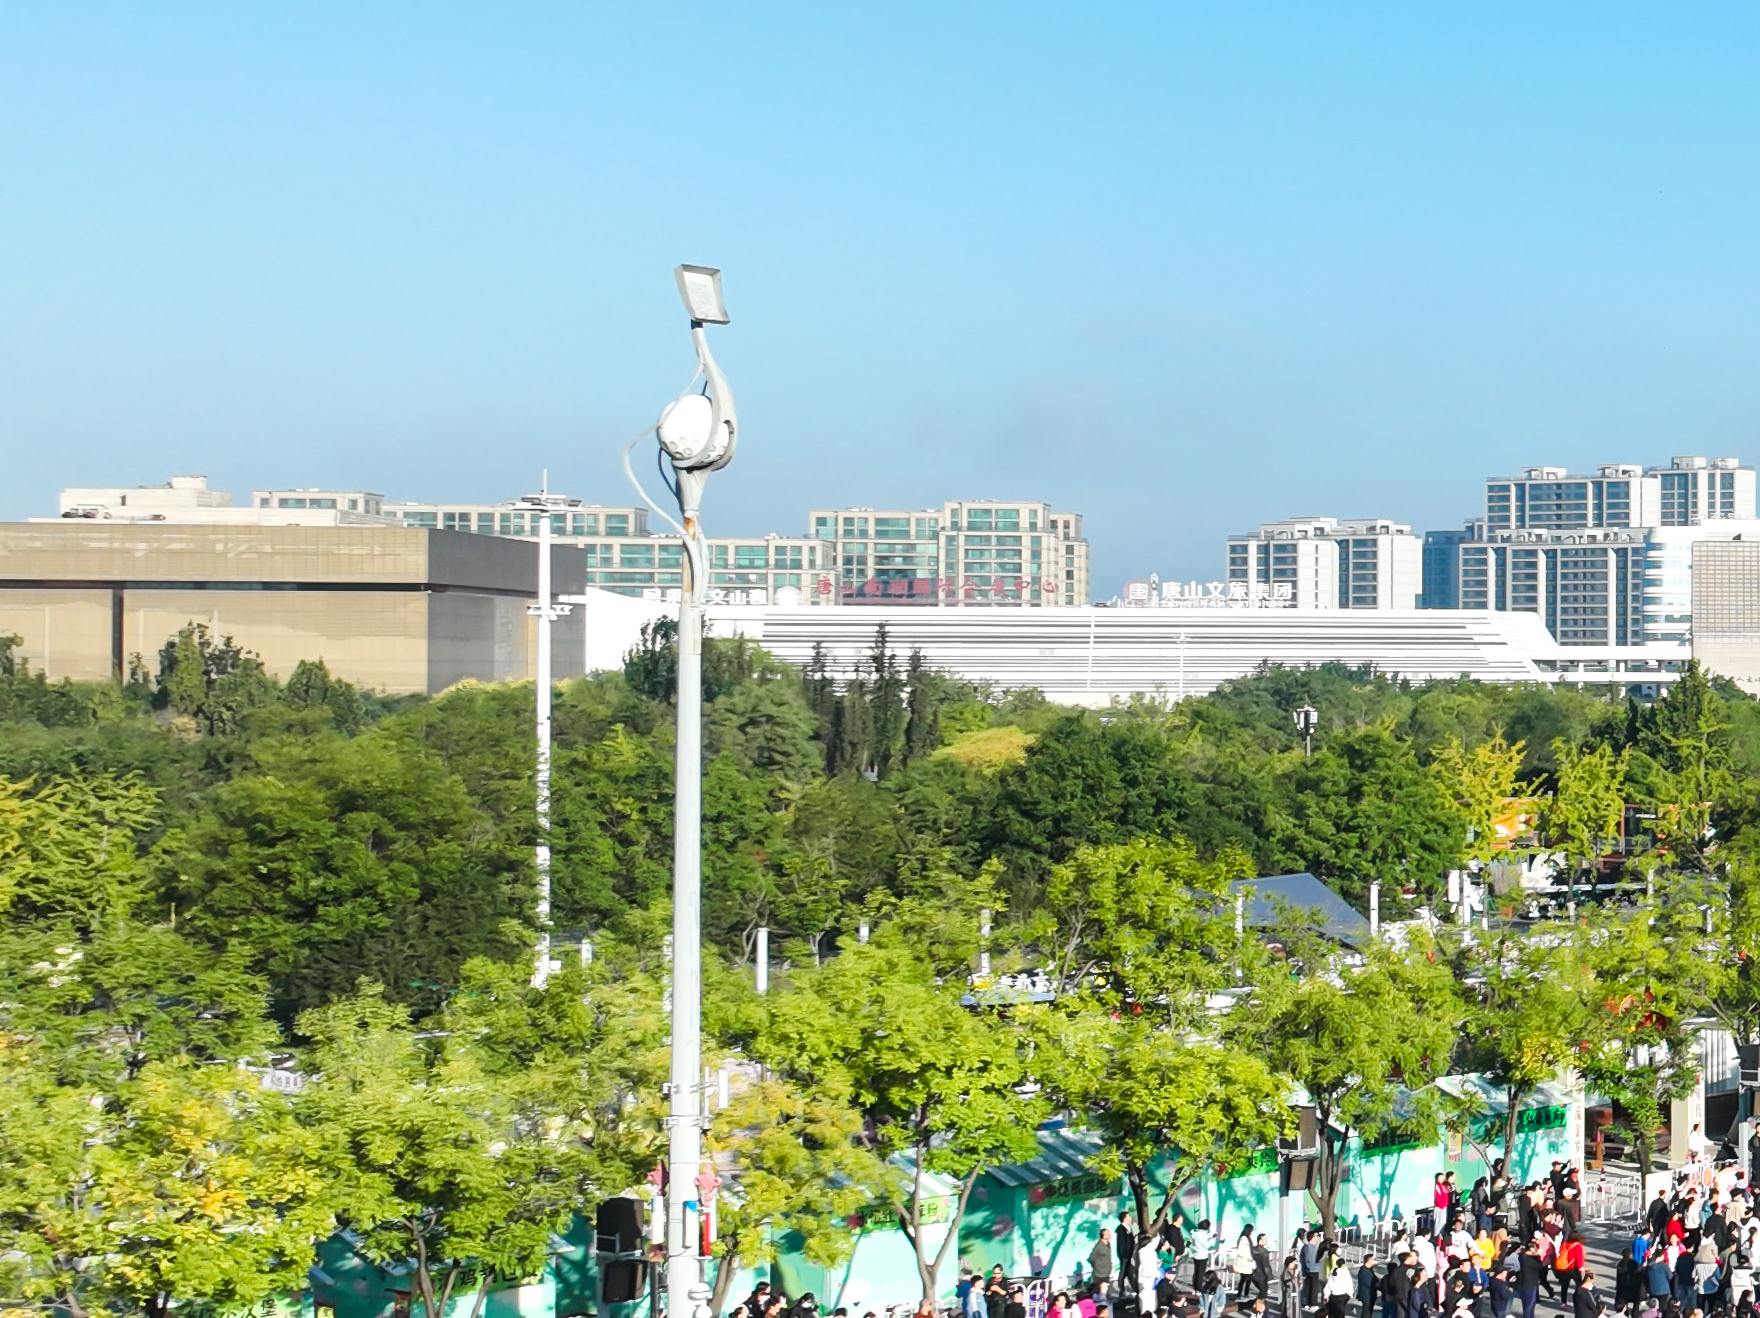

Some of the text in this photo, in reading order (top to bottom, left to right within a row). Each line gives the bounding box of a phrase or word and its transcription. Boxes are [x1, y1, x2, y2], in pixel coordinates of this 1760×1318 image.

[1161, 580, 1292, 601] 唐山文旅集团
